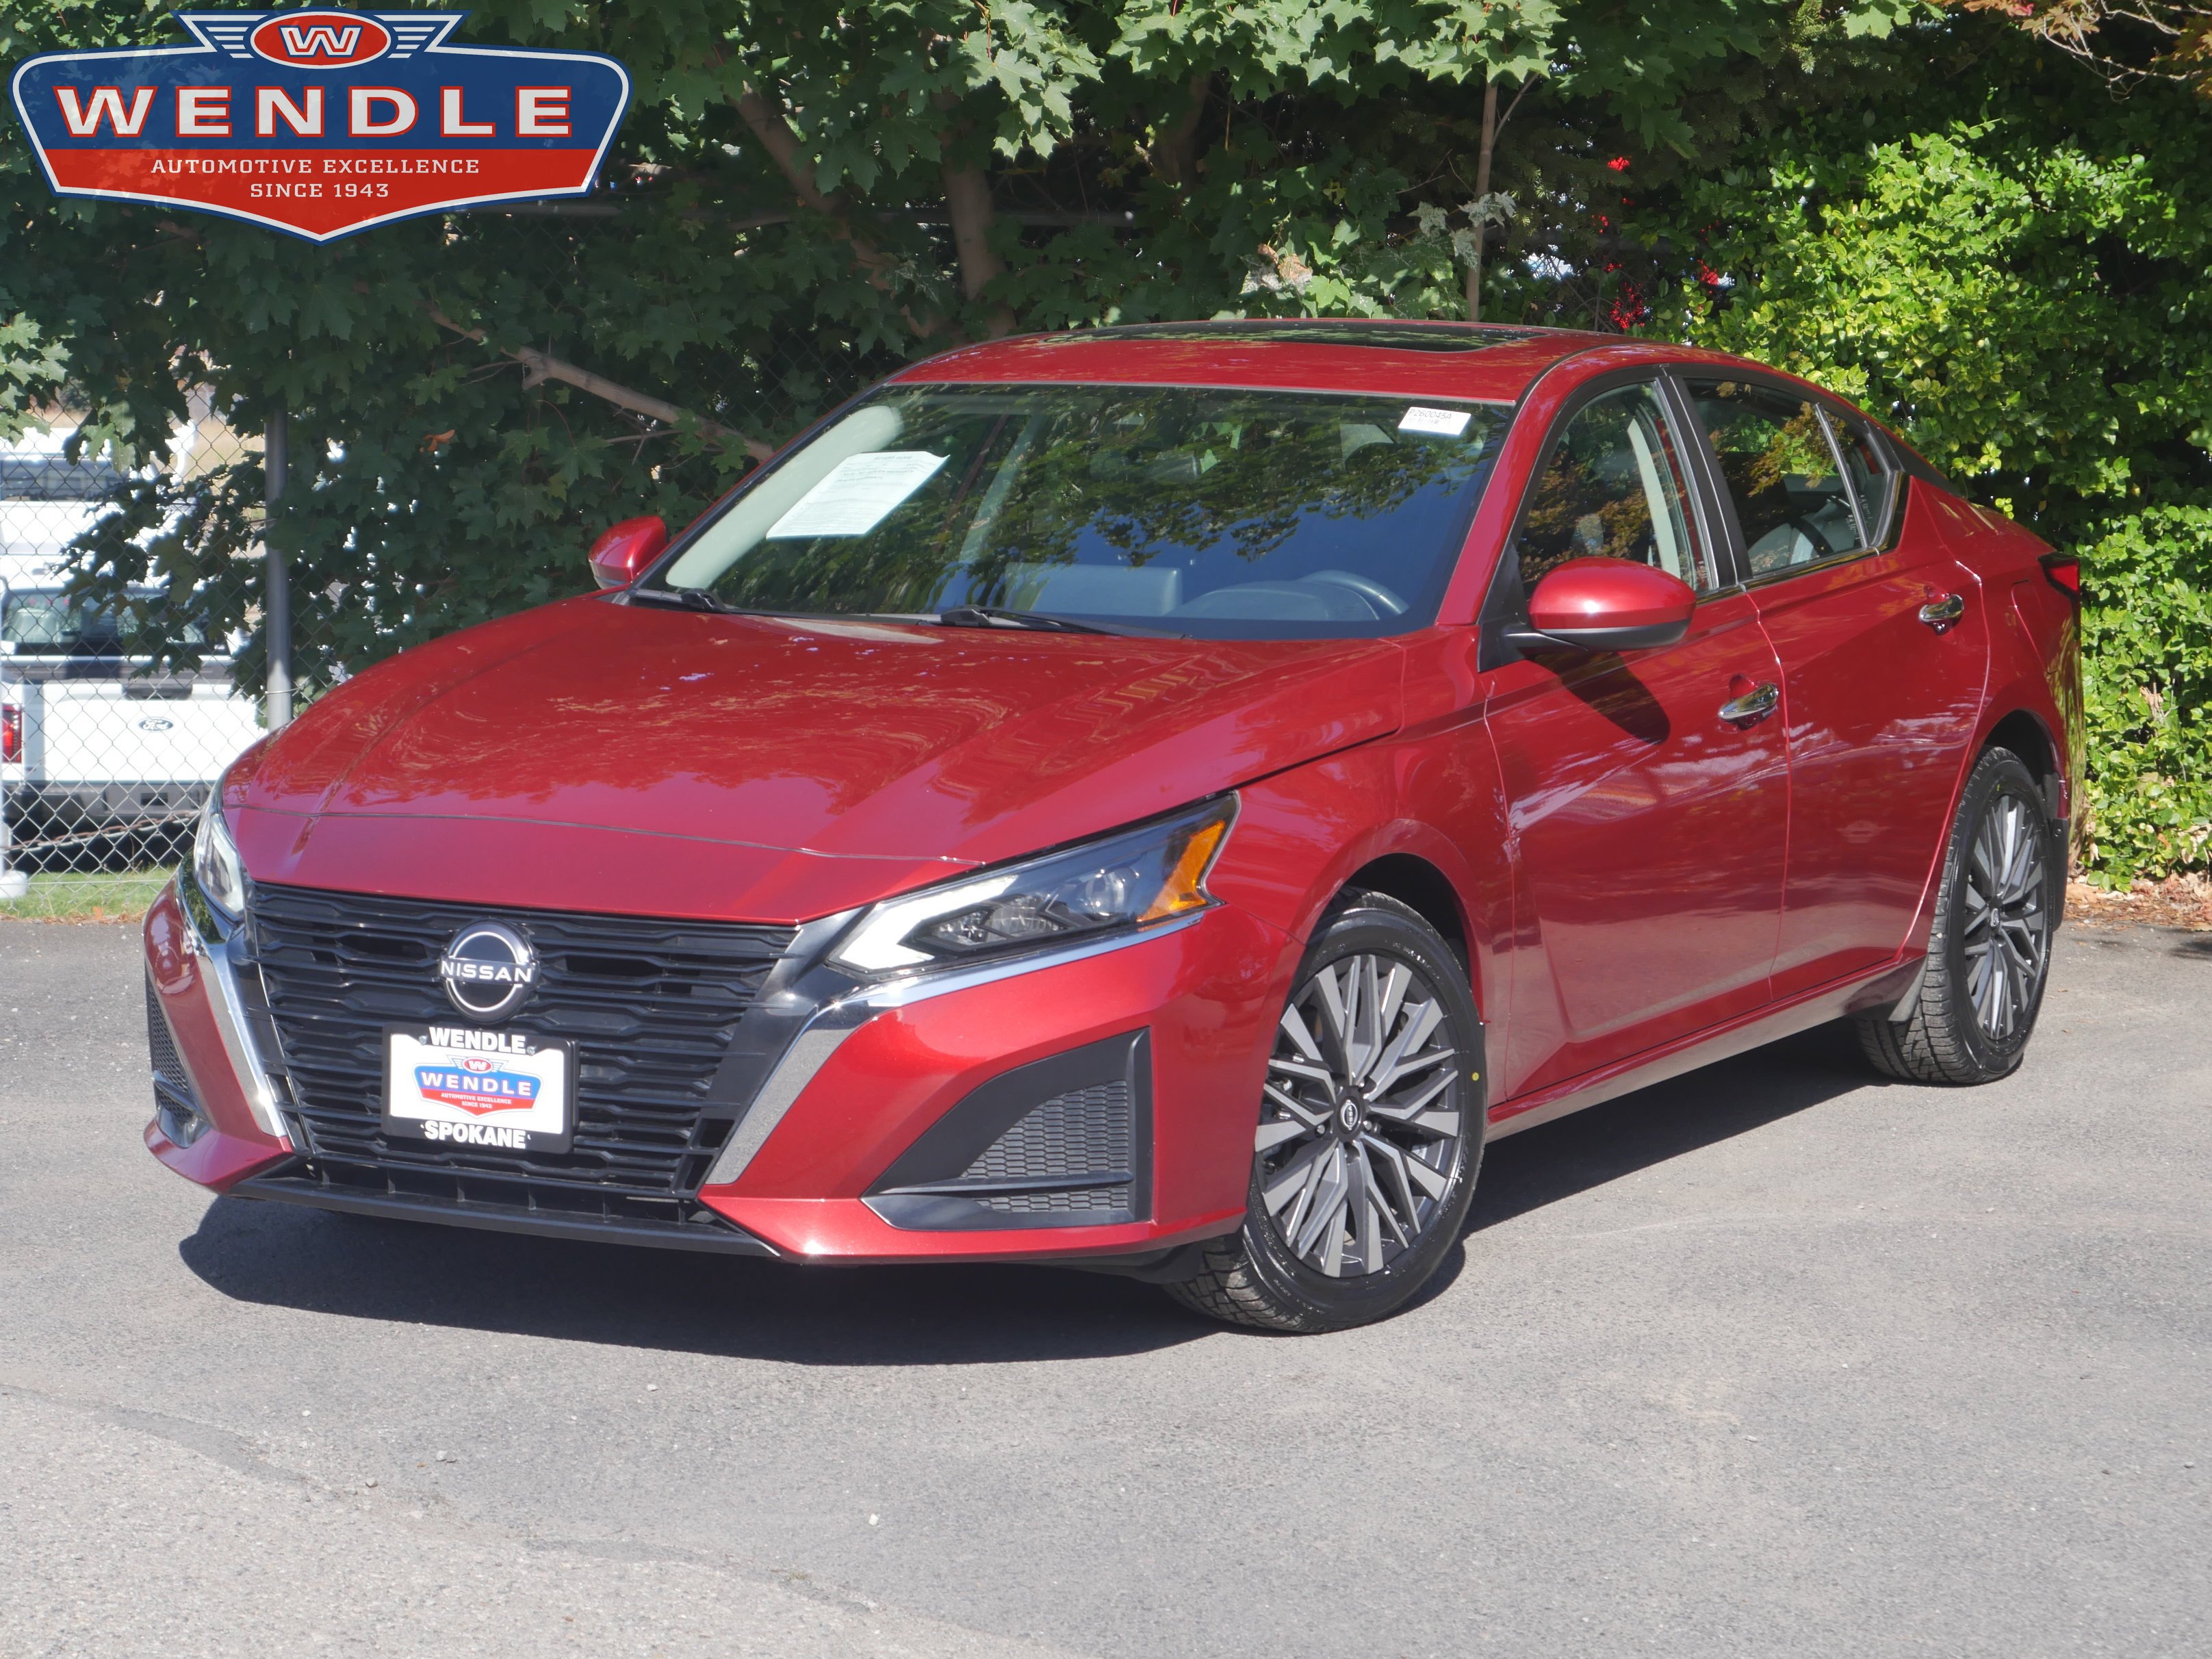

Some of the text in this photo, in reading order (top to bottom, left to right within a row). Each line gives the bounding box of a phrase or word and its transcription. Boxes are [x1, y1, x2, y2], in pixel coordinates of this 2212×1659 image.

[142, 719, 168, 730] Ford
[441, 960, 532, 983] NISSAN
[428, 1026, 526, 1055] WENDLE
[467, 1060, 488, 1071] W
[420, 1071, 532, 1096] WENDLE
[441, 1092, 512, 1105] AUTOMOTIVE EXCELLENCE
[424, 1120, 526, 1149] SPOKANE
